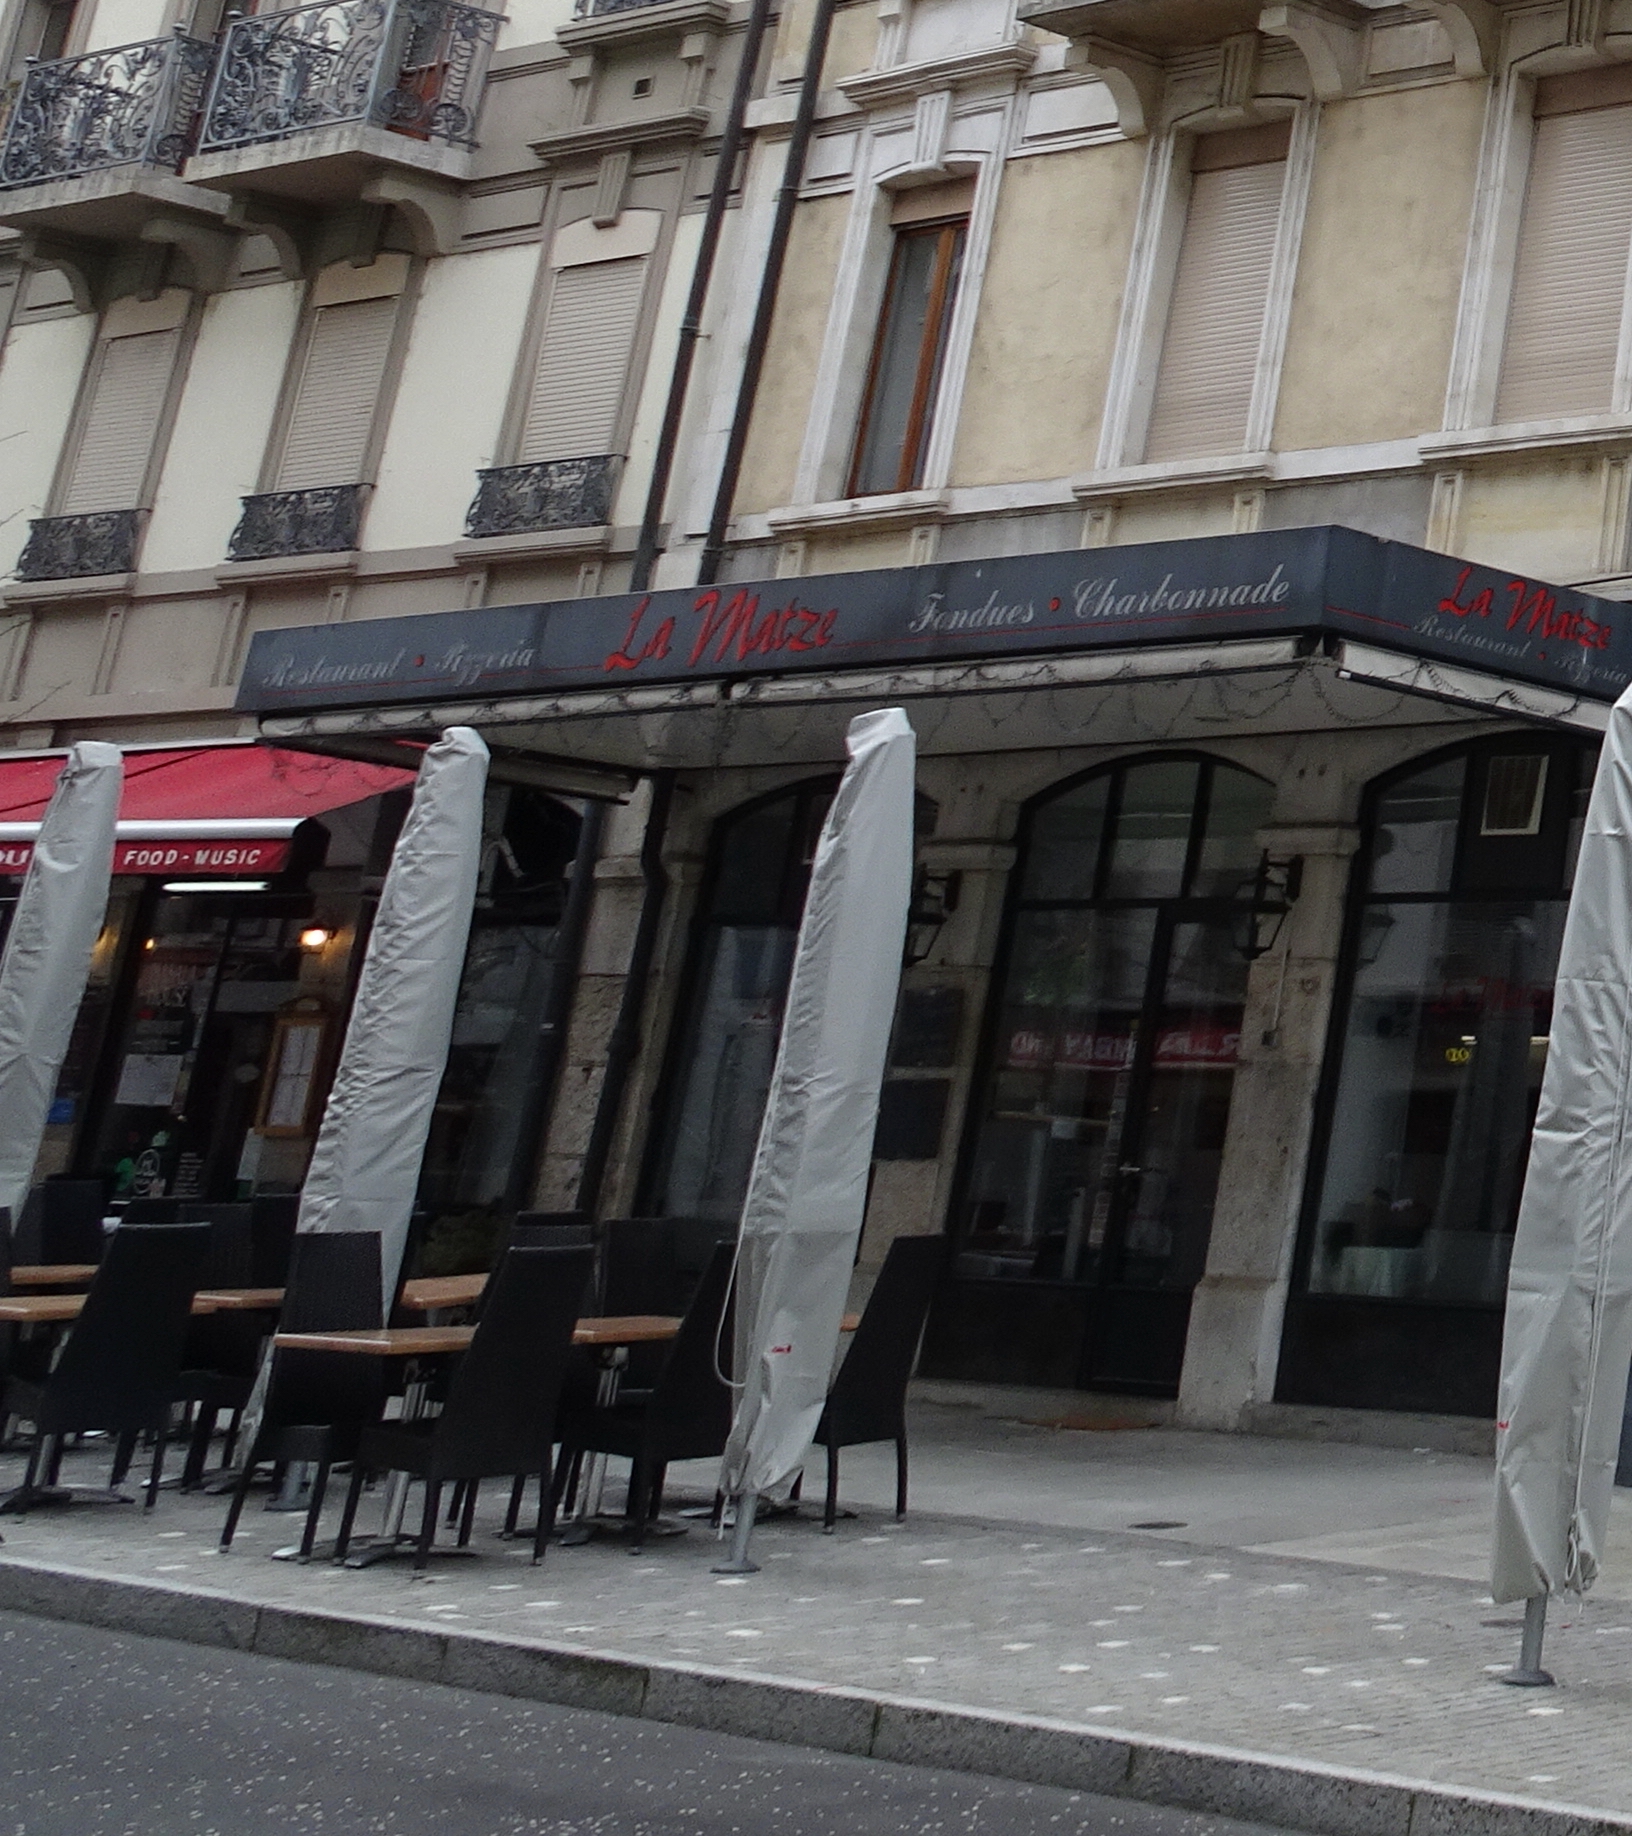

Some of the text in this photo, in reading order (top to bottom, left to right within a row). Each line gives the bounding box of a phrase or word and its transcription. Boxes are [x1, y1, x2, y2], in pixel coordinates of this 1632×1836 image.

[603, 588, 840, 672] La Matze
[909, 564, 1290, 634] Fondues Charbonnade
[1437, 566, 1613, 650] La Matze
[262, 648, 407, 688] Restaurant
[1413, 615, 1532, 659] Restaurant
